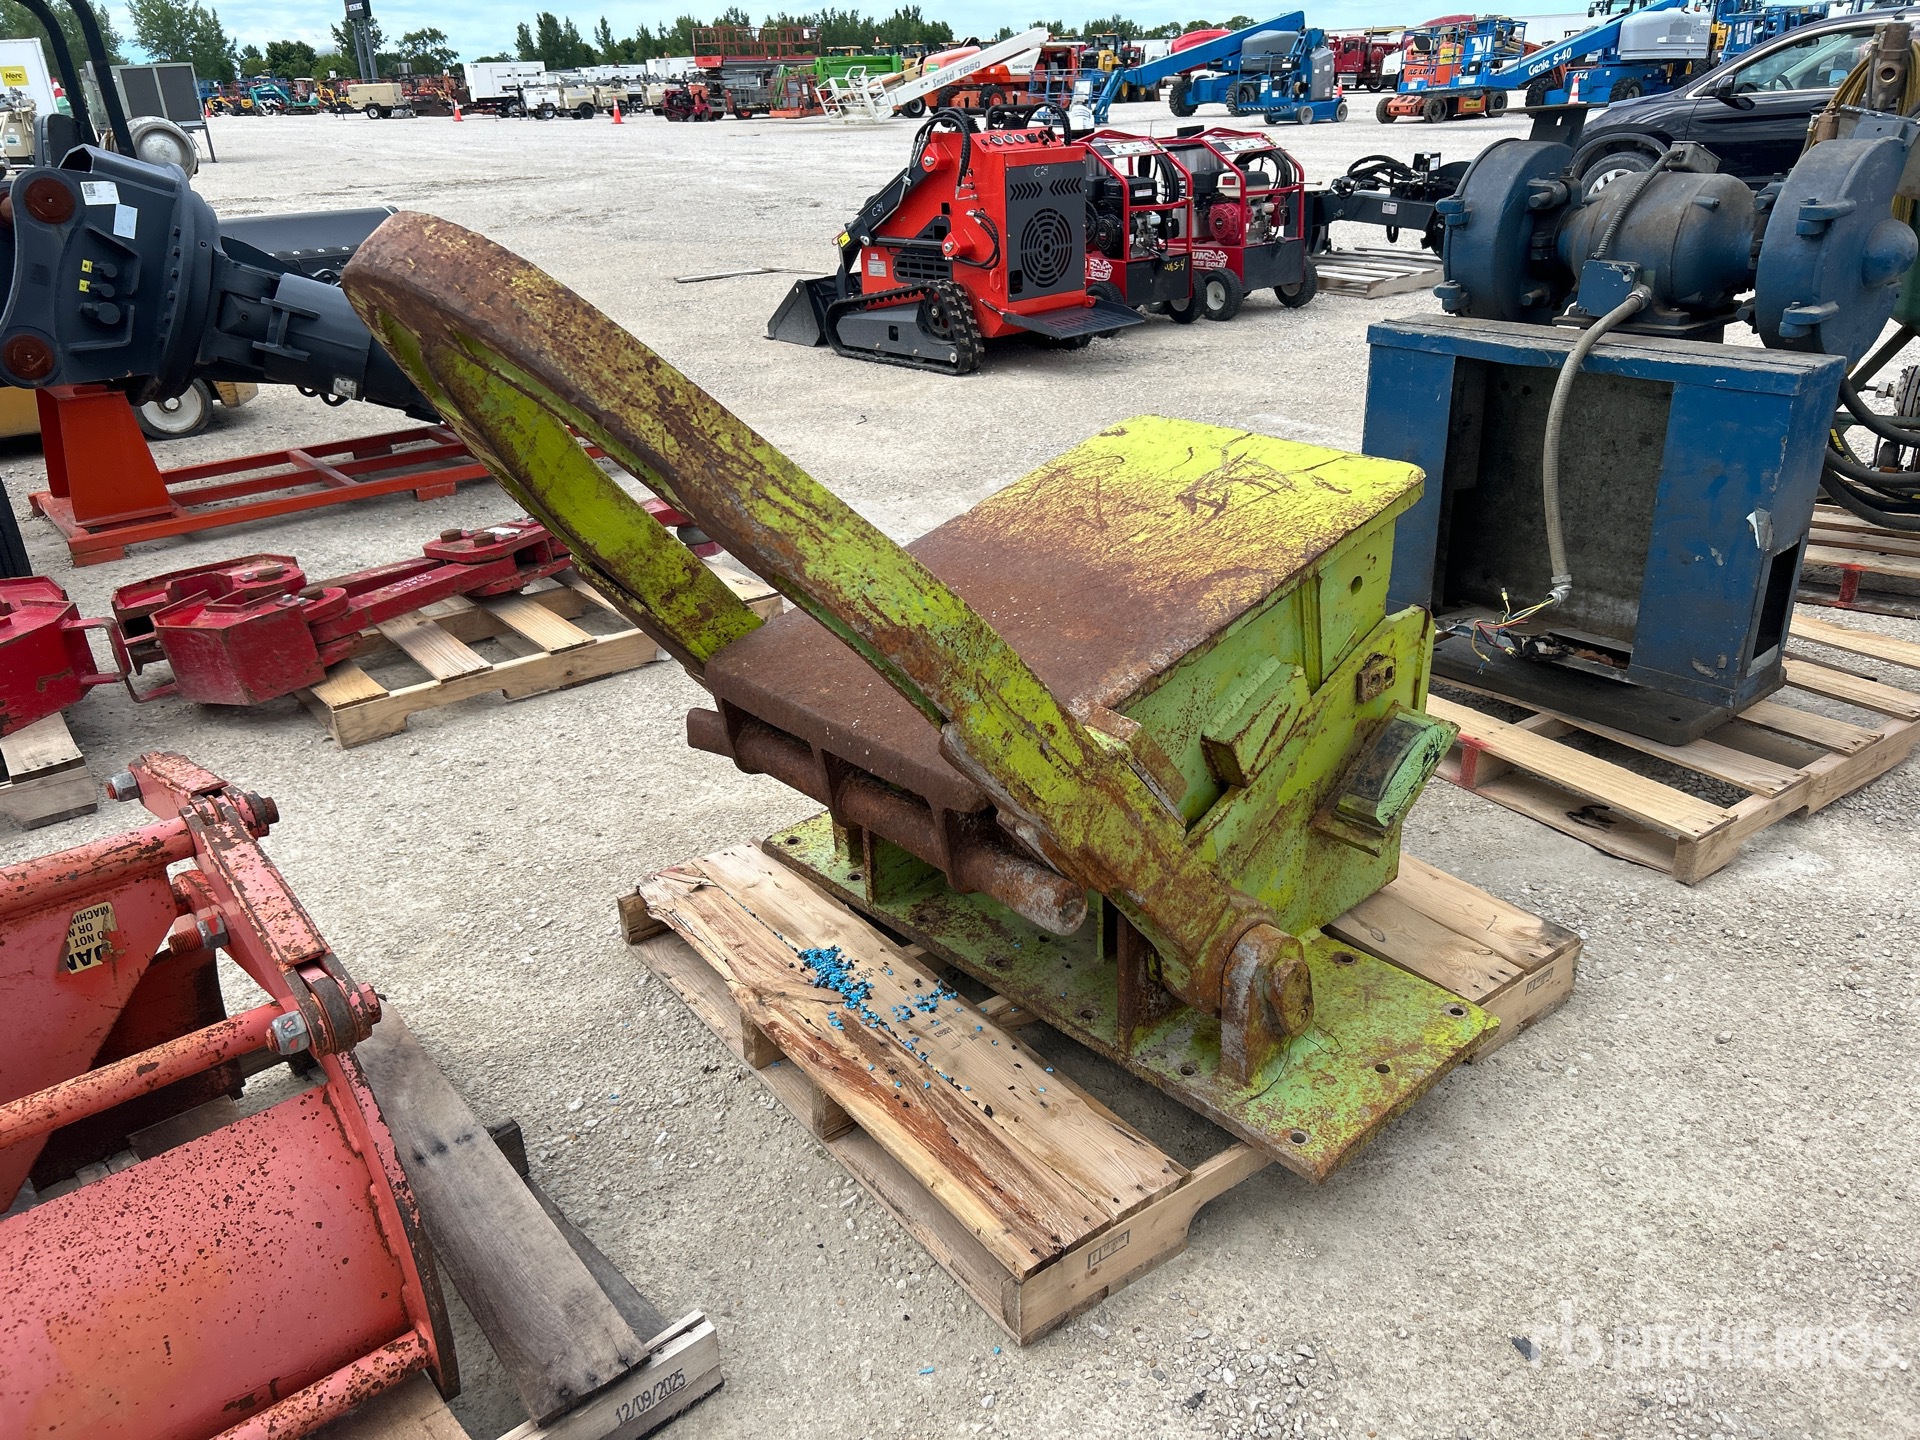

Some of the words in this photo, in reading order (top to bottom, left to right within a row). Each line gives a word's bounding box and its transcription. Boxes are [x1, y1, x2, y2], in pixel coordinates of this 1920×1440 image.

[1528, 59, 1550, 76] Genie
[1552, 46, 1572, 65] S-40
[932, 70, 955, 88] Snorkel
[958, 61, 981, 75] TB60
[1034, 165, 1048, 178] C24
[871, 201, 885, 217] C24
[1091, 271, 1108, 279] GOLD
[77, 922, 93, 935] OR
[74, 934, 95, 949] NOT
[615, 1367, 686, 1426] 12/09/2025
